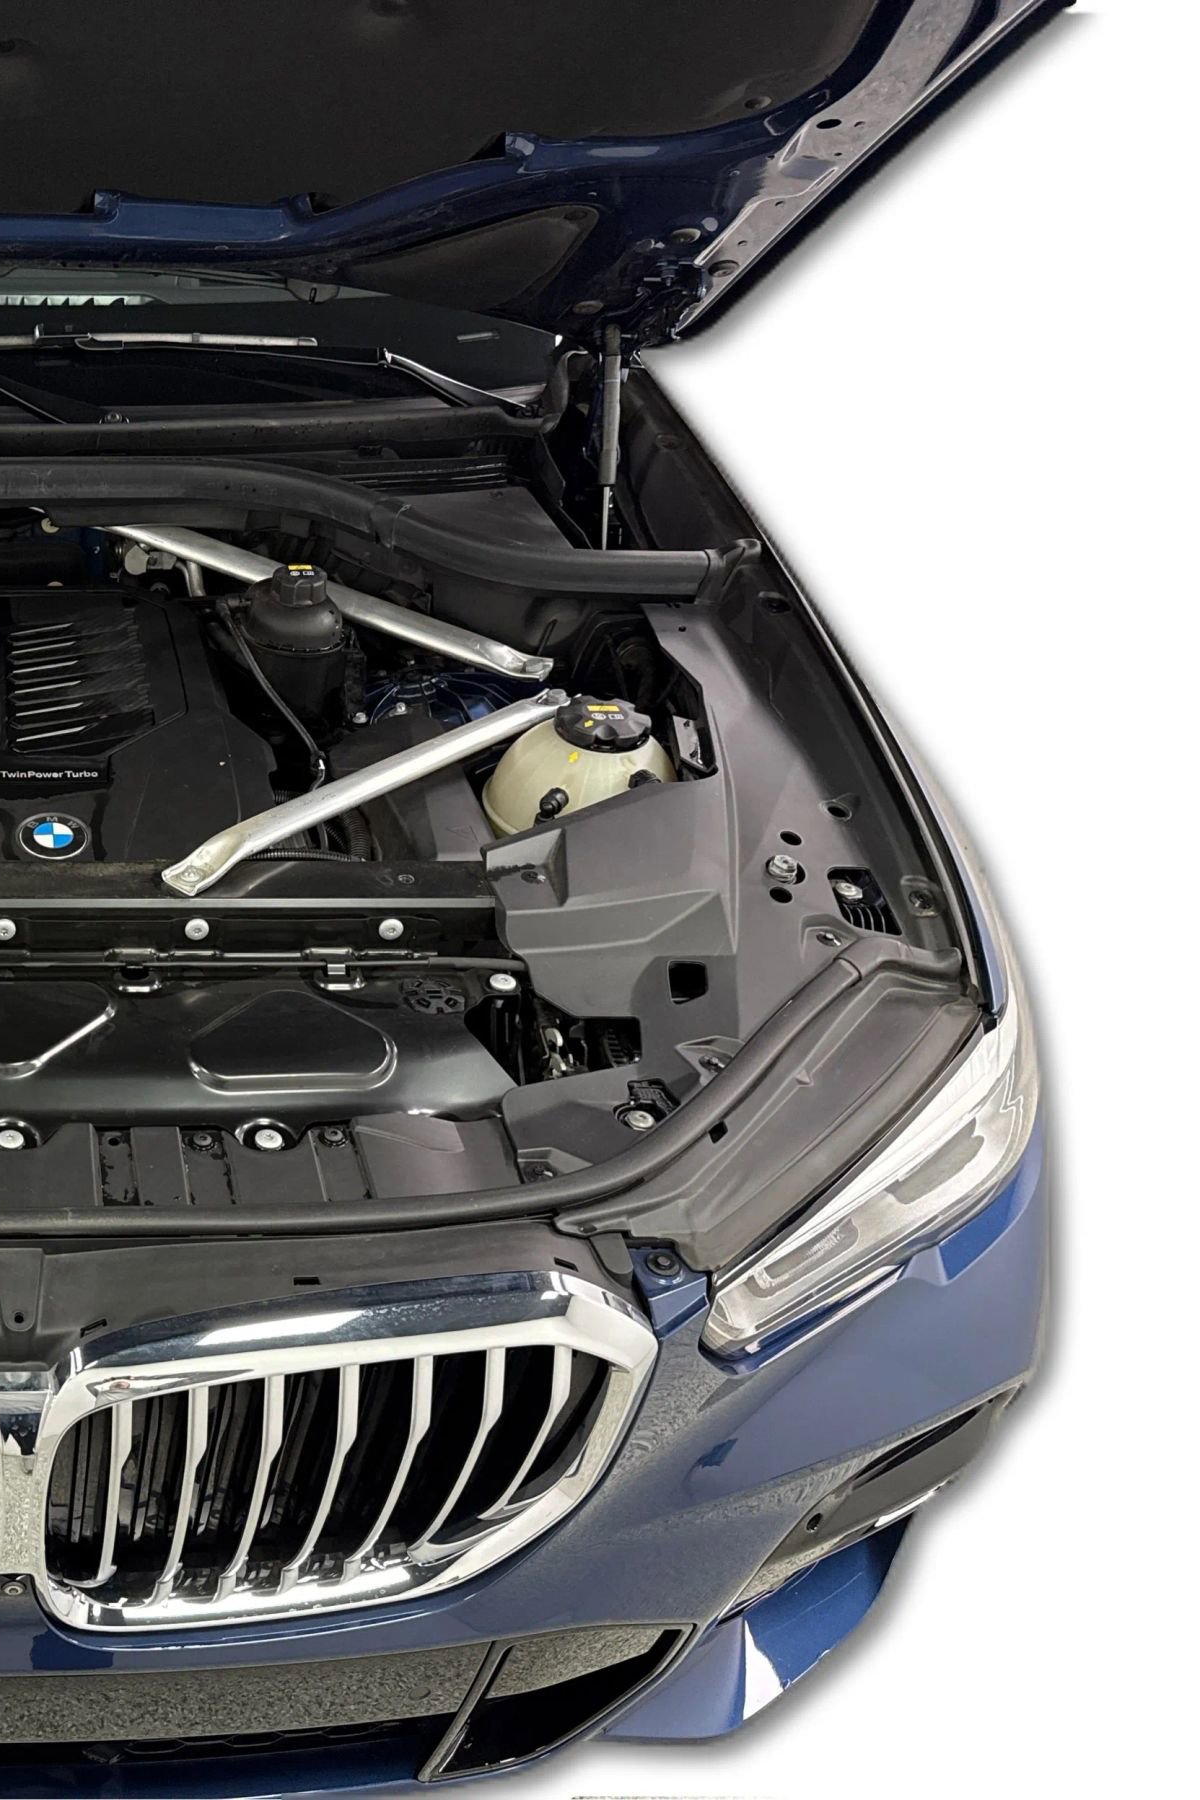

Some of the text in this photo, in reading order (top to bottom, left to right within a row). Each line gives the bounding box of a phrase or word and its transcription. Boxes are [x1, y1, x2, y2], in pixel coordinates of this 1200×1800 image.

[0, 769, 99, 779] TwinPower Turbo
[26, 816, 80, 829] BMW
